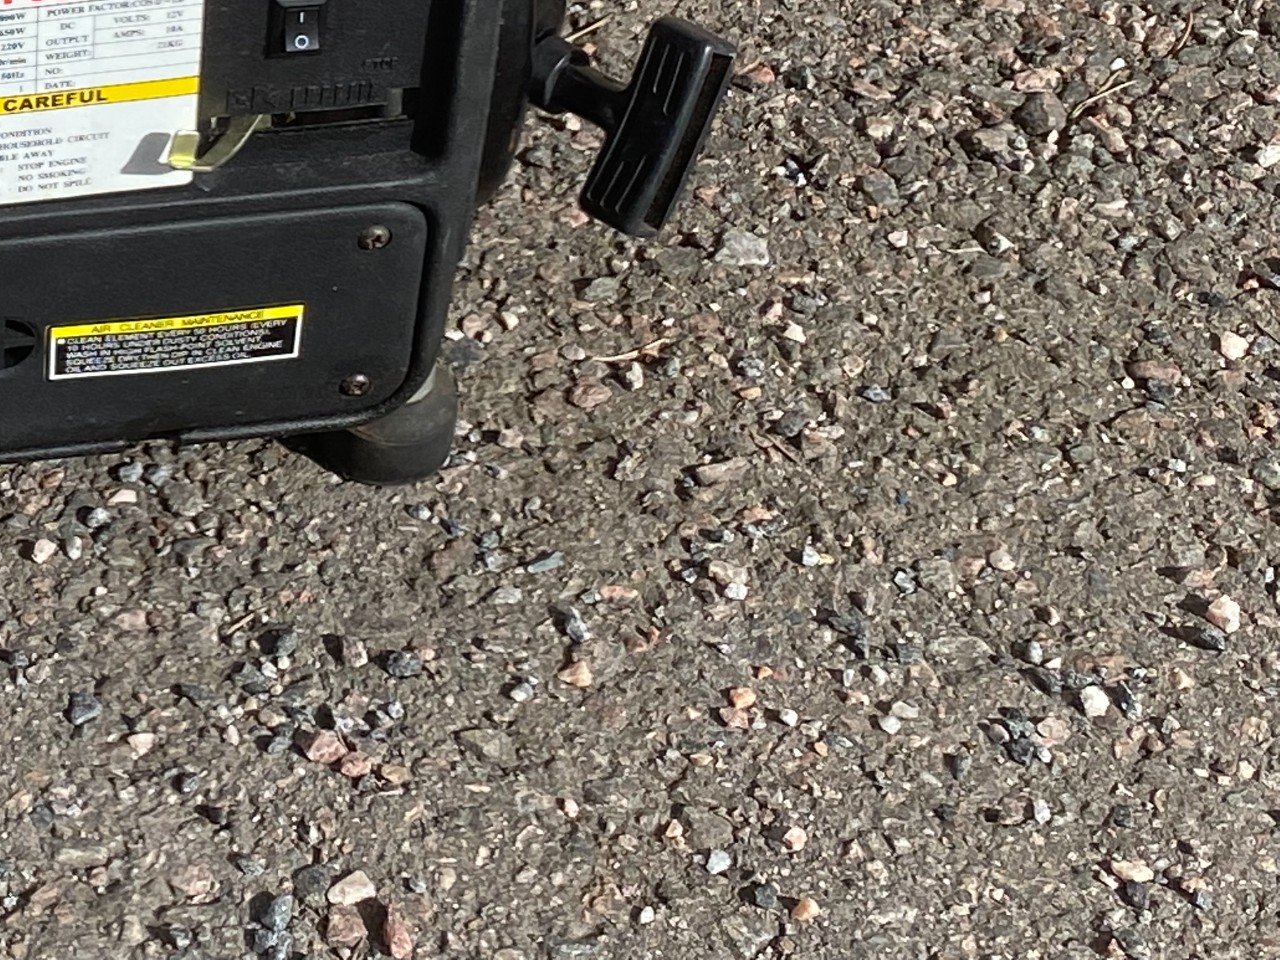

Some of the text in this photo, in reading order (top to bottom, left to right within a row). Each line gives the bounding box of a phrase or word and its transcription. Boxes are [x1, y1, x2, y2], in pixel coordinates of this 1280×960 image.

[47, 7, 85, 17] POWER
[60, 22, 76, 30] DC
[114, 14, 150, 24] VOLTS:
[45, 35, 89, 46] OUTPUT
[113, 29, 145, 39] AMPS:
[1, 42, 25, 52] 220V
[45, 49, 91, 60] WEIGHT:
[45, 67, 63, 75] NO:
[44, 81, 76, 90] DATE:
[3, 90, 107, 113] CAREFUL
[0, 137, 63, 151] HOUSEHOLD
[67, 132, 110, 143] CIRCUIT
[23, 149, 54, 160] AWAY
[18, 162, 44, 172] STOP
[48, 157, 87, 168] ENGINE
[18, 168, 86, 182] NO SMOKING
[18, 177, 92, 193] DO NOT SPILL
[91, 310, 264, 333] AIR CLEANER MAINTENANCE
[67, 336, 102, 345] CLEAN
[104, 332, 155, 342] ELEMENT
[157, 329, 191, 338] EVERY
[208, 324, 247, 333] HOURS
[66, 350, 97, 359] WASH
[214, 336, 262, 347] SOLVENT
[81, 342, 120, 351] HOURS
[122, 338, 161, 347] UNDER
[163, 336, 197, 344] DUSTY
[66, 356, 115, 366] SQUEEZE
[205, 346, 240, 355] CLEAN
[243, 340, 283, 351] ENGINE
[110, 360, 160, 370] SQUEEZE
[162, 357, 185, 365] OUT
[187, 353, 230, 364] EXCESS
